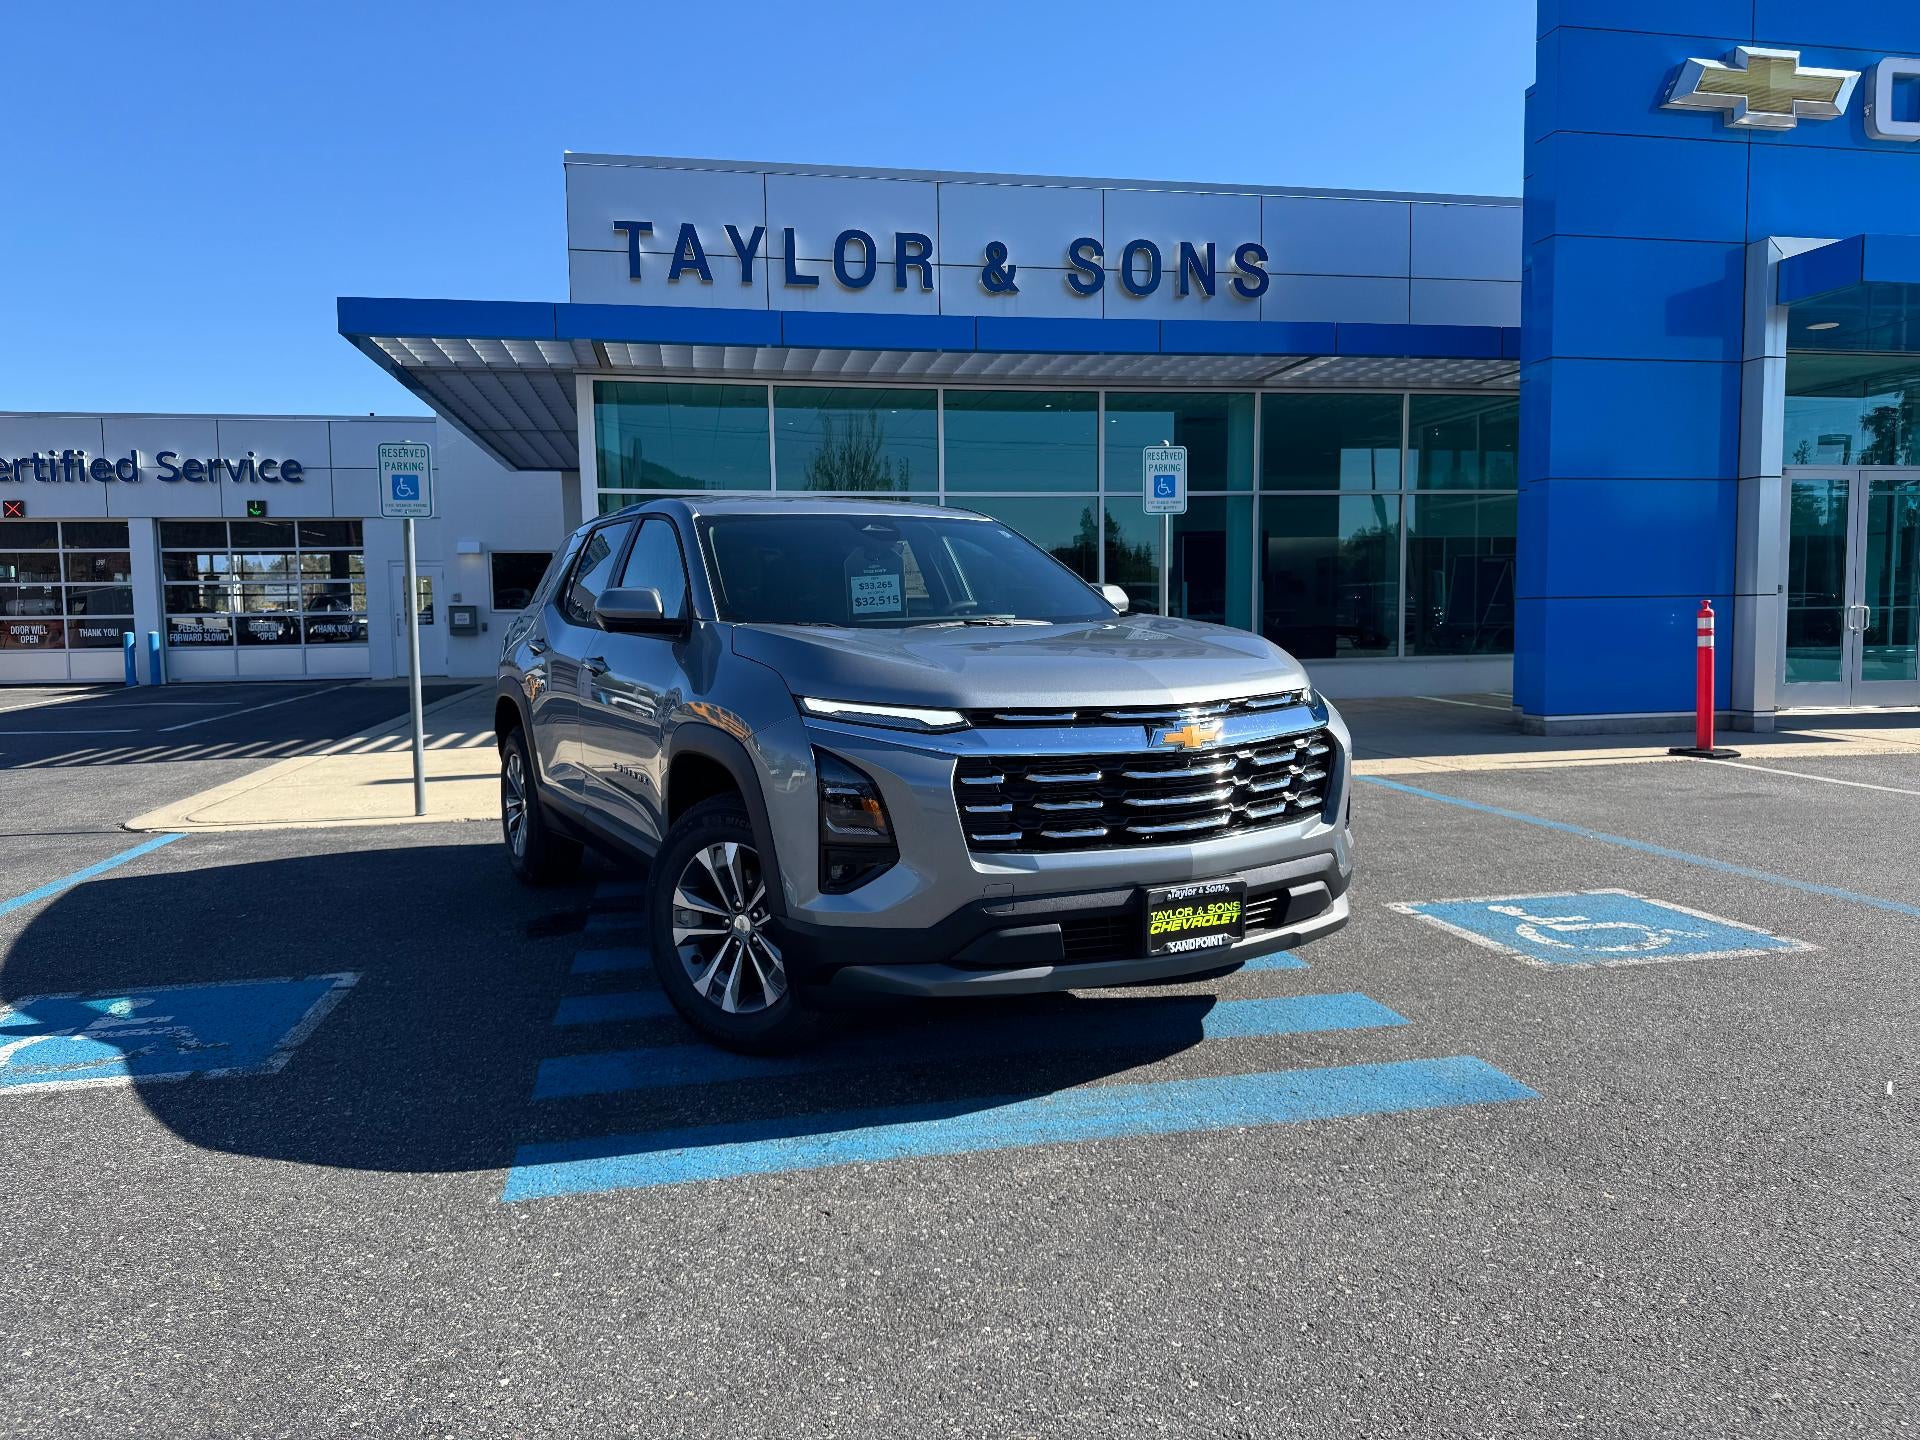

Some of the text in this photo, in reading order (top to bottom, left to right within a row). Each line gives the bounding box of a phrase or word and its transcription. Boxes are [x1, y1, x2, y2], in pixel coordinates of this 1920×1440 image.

[613, 220, 1271, 298] TAYLOR & SONS
[381, 448, 426, 458] RESERVED
[1147, 451, 1183, 461] RESERVED
[155, 451, 304, 483] Service
[384, 461, 424, 471] PARKING
[1148, 463, 1181, 472] PARKING
[859, 581, 893, 590] $33,265
[855, 595, 900, 607] $32,515
[10, 625, 48, 635] DOOR WILL
[79, 628, 119, 637] THANK YOU!
[178, 624, 203, 633] PLEASE
[315, 624, 353, 633] THANK YOU!
[20, 635, 39, 644] OPEN
[170, 632, 230, 642] FORWARD SLOWLY
[260, 631, 277, 641] OPEN
[1170, 887, 1197, 899] Taylor
[1205, 883, 1226, 894] Sons
[1151, 900, 1241, 921] TAYLOR & SONS
[1150, 912, 1241, 935] CHEVROLET
[1169, 935, 1223, 953] SANDPOINT
